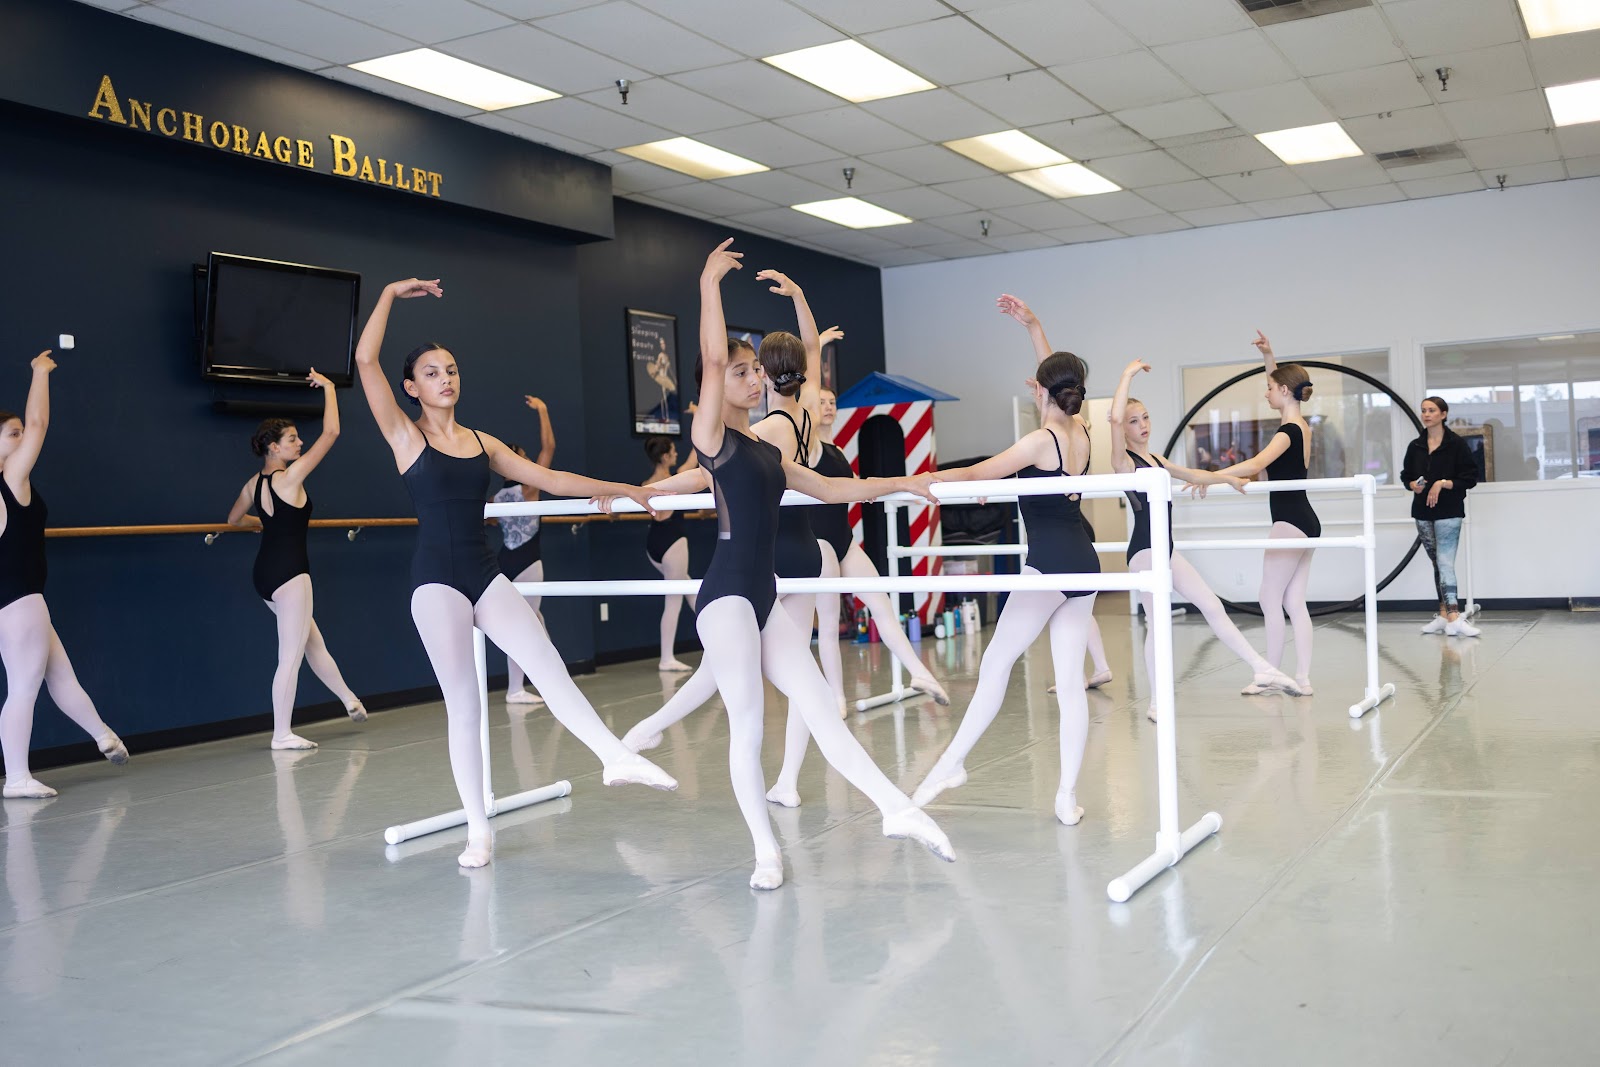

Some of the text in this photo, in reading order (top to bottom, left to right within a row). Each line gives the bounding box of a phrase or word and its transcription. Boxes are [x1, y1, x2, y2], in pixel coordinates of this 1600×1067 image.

[88, 74, 442, 197] ANCHORAGE BALLET
[631, 325, 659, 339] Sleeping
[632, 338, 654, 350] Beauty
